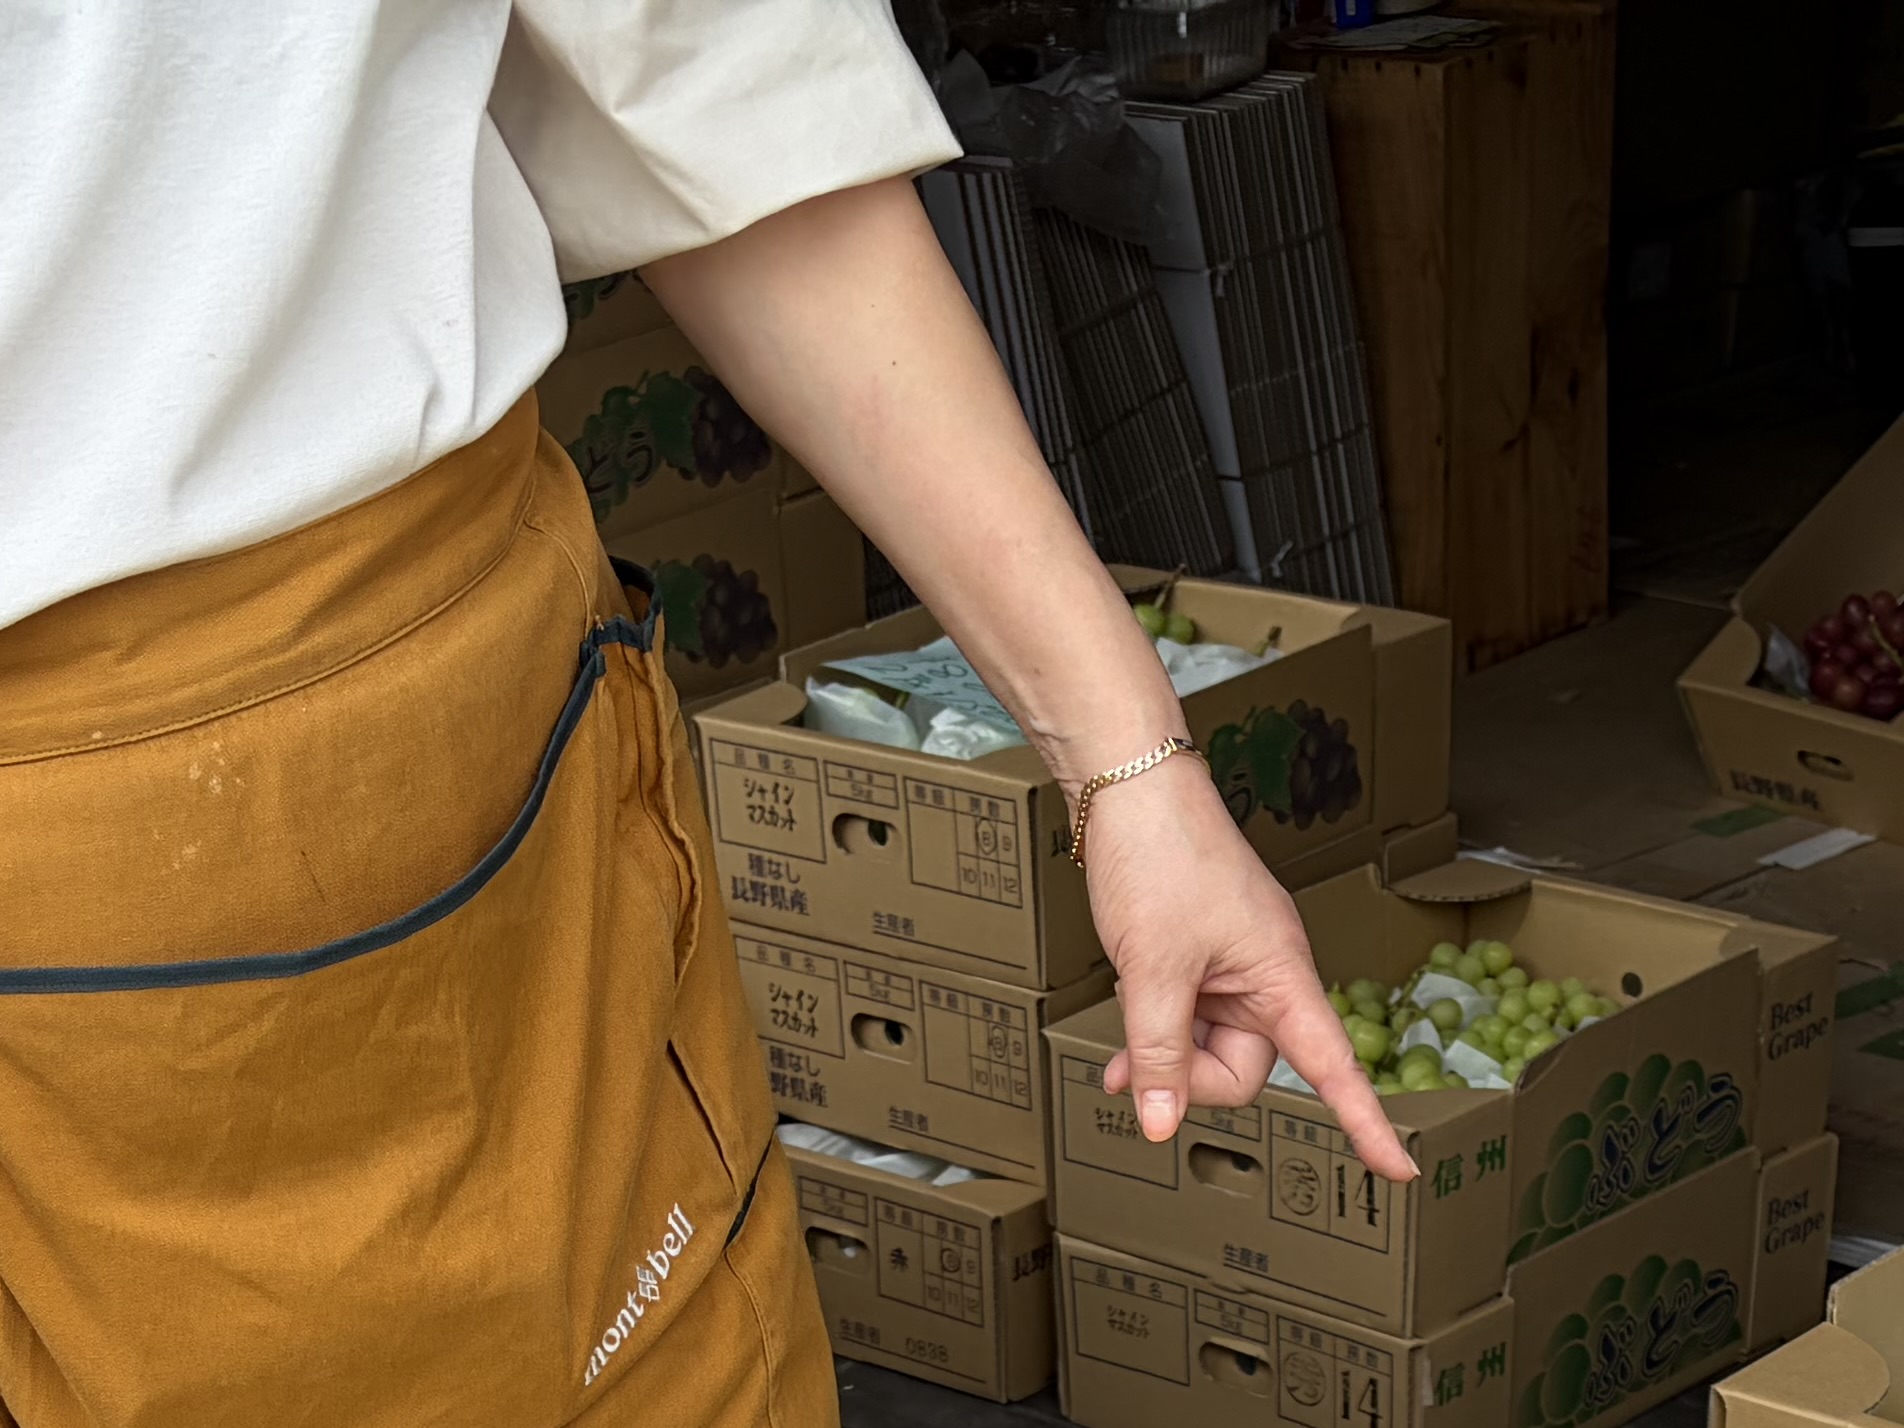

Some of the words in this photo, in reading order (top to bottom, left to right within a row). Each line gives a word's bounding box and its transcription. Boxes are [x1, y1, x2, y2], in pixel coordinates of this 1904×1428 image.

[743, 778, 795, 805] シャイン
[745, 804, 797, 832] マスカット
[748, 853, 801, 885] 種なし
[731, 876, 810, 917] 長野県産
[768, 982, 818, 1013] シャイン
[1771, 992, 1814, 1032] Best
[770, 1008, 819, 1038] マスカット
[1768, 1016, 1830, 1061] Grape
[1583, 1072, 1742, 1214] ぶどう
[1432, 1135, 1507, 1198] 信州
[1768, 1188, 1810, 1226] Best
[1764, 1209, 1826, 1255] Grape
[1223, 1242, 1270, 1273] 生産者
[1583, 1268, 1740, 1409] ぶどう
[1435, 1342, 1506, 1407] 信州
